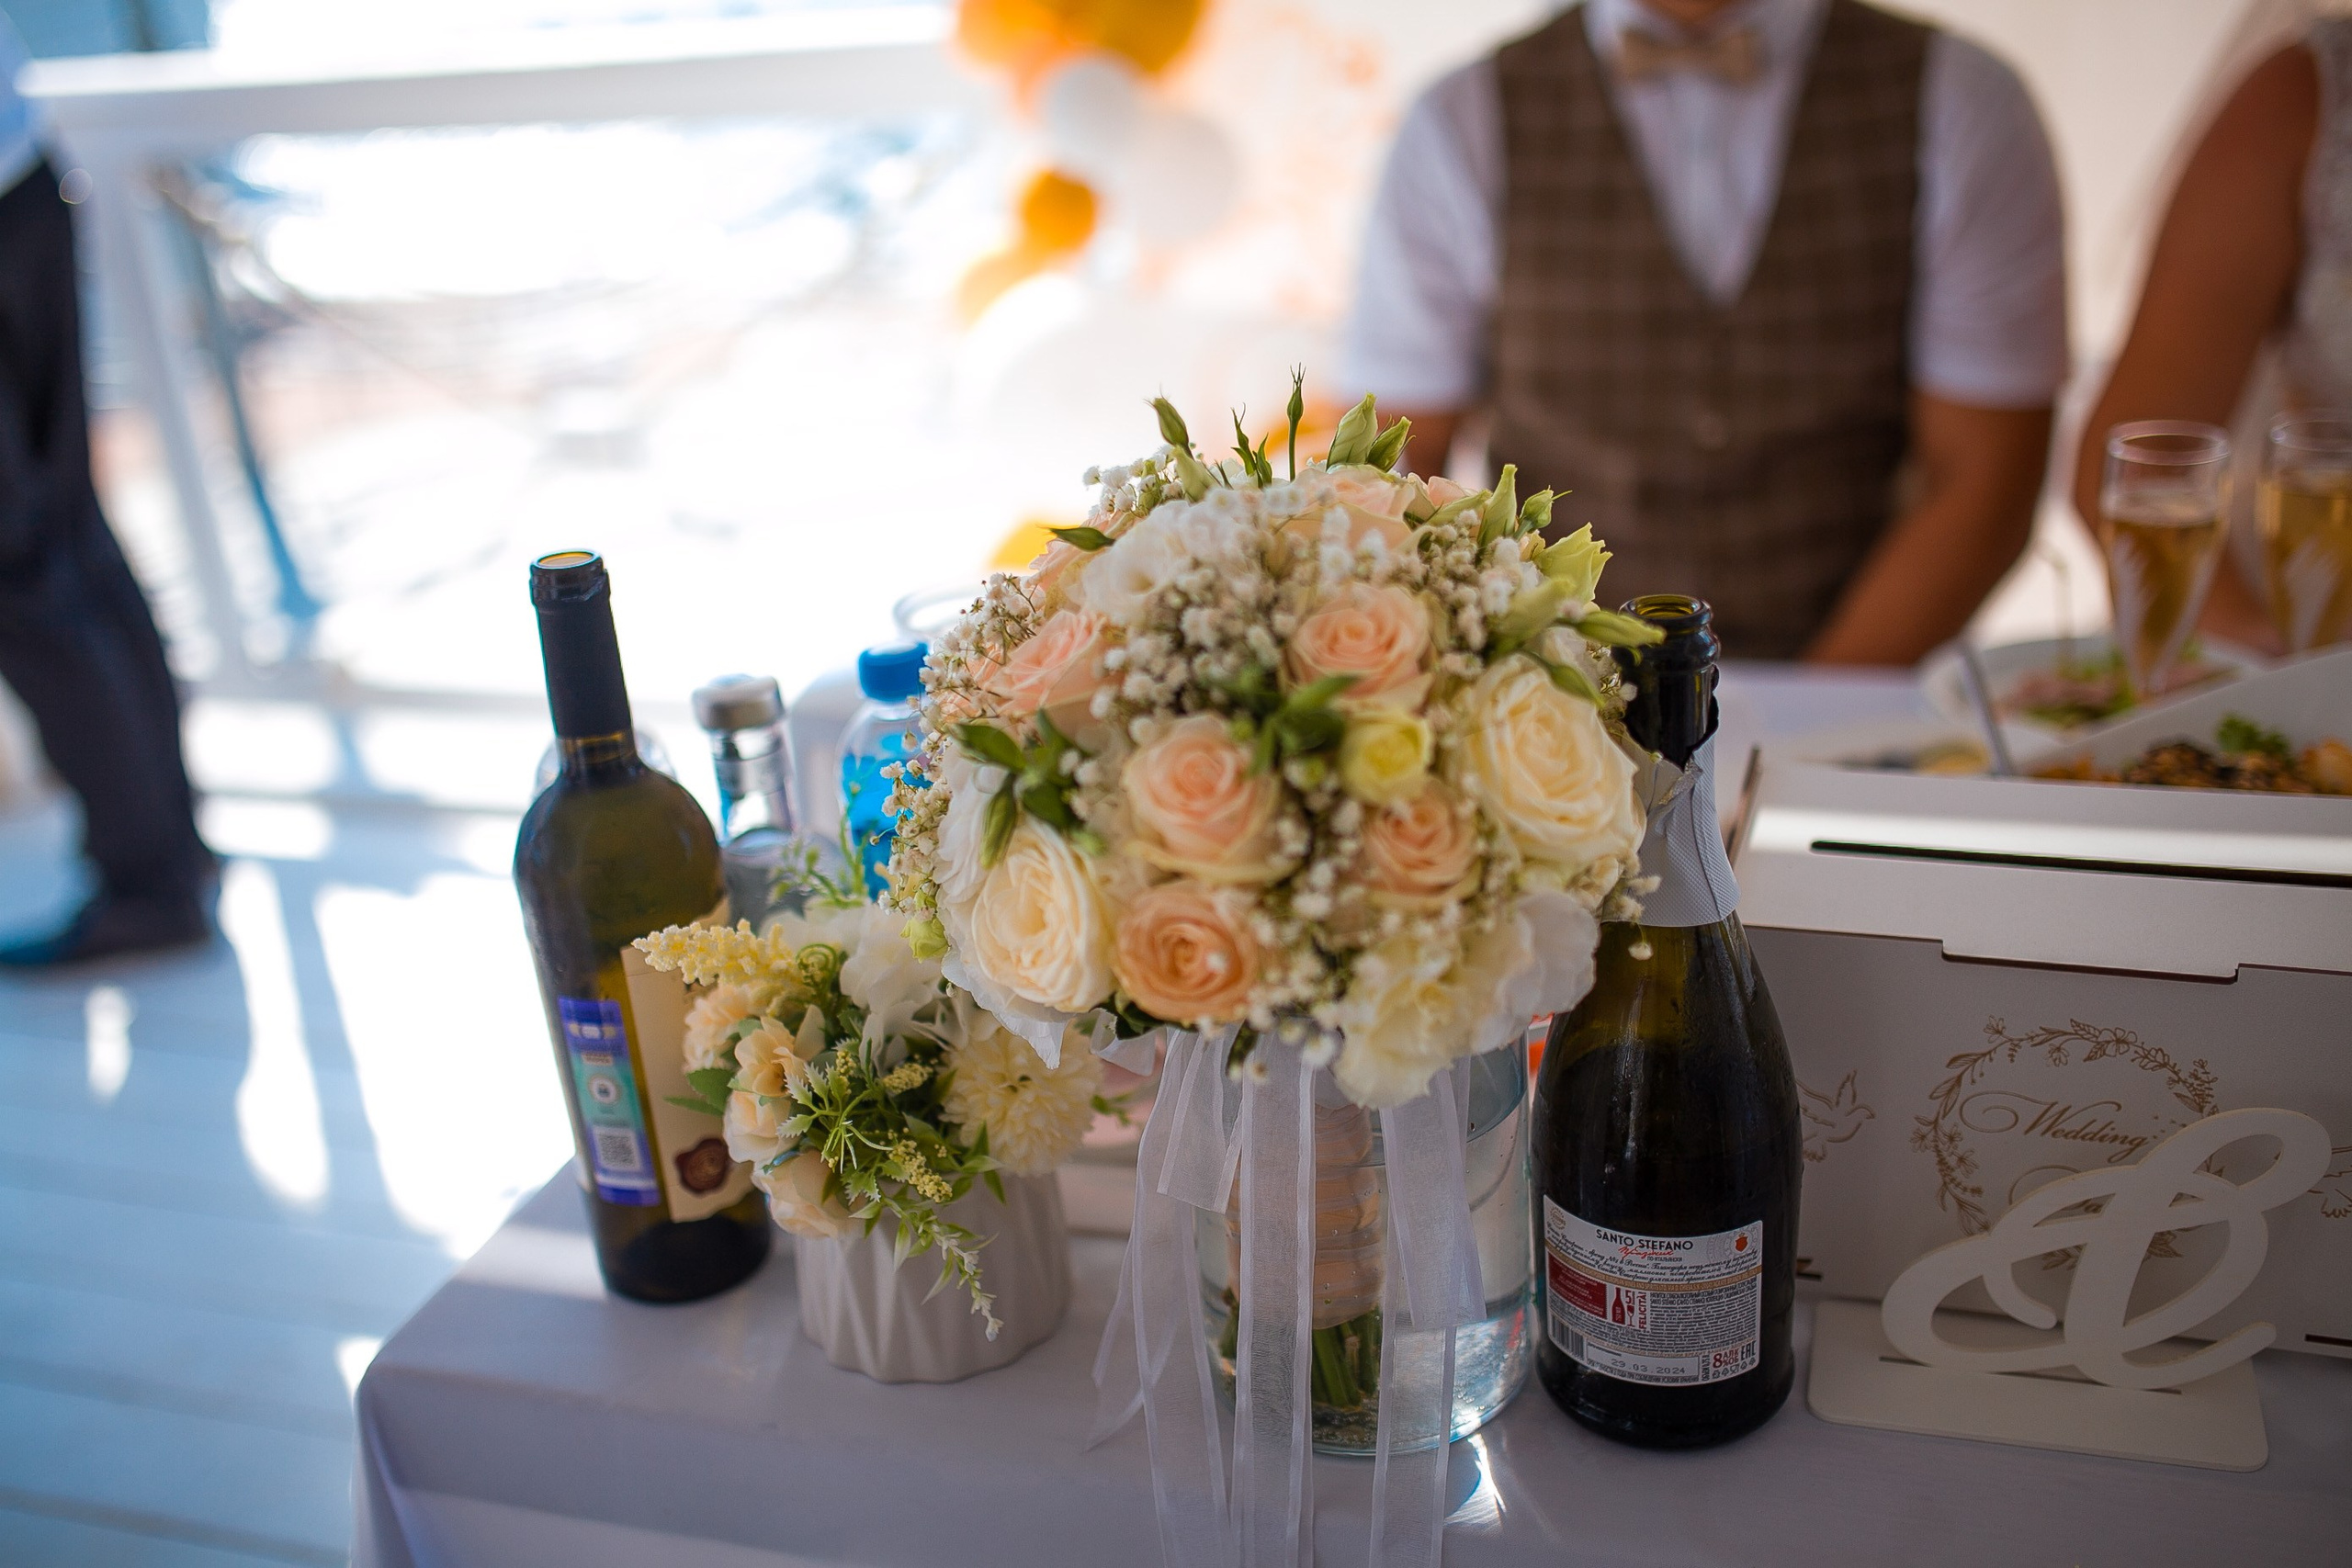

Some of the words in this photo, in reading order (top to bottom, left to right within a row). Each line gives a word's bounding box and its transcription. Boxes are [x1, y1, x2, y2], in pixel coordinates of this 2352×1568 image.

[1960, 1090, 2150, 1164] Wedding
[1596, 1229, 1634, 1247] SANTO
[1638, 1239, 1693, 1251] STEFANO
[1624, 1290, 1632, 1304] 5
[1637, 1292, 1647, 1330] FELICITÀ!
[1713, 1352, 1723, 1369] 8
[1723, 1348, 1739, 1358] АЛК
